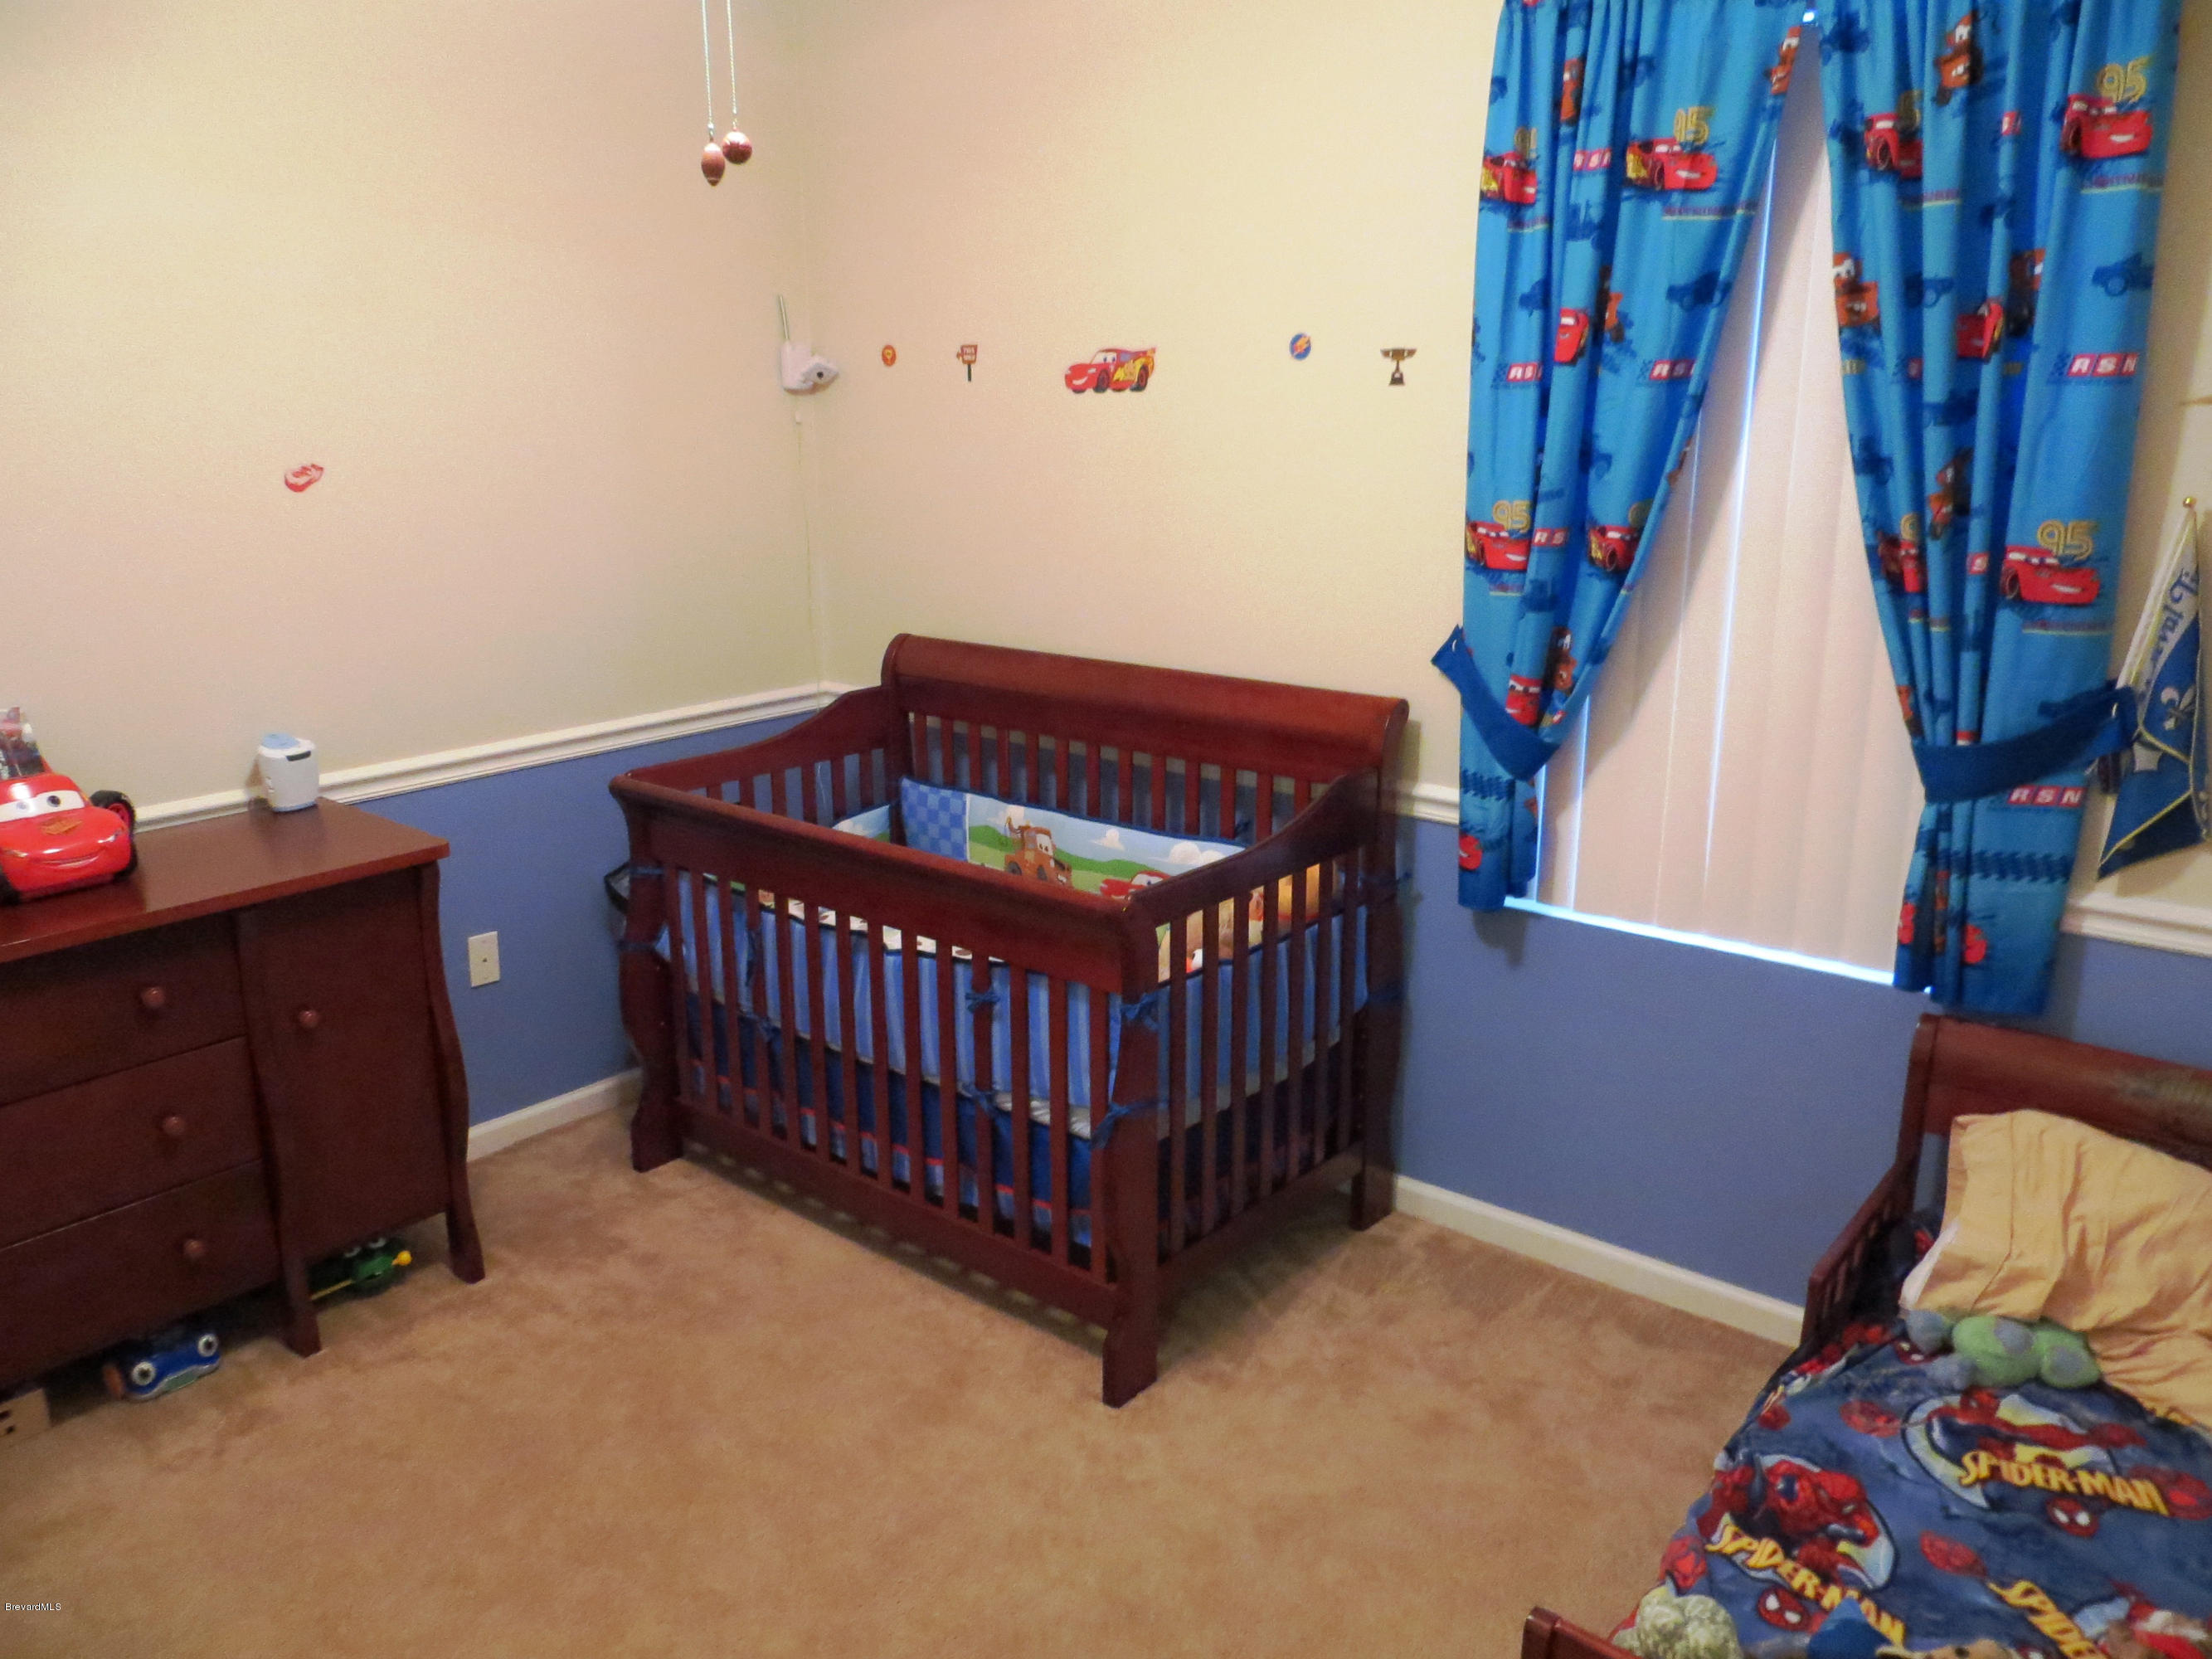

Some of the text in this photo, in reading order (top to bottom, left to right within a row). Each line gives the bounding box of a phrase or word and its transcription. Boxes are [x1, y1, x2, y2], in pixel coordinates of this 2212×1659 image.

[2096, 55, 2158, 103] 95
[1492, 499, 1533, 533] 95
[2037, 519, 2101, 561] 95
[1958, 1449, 2170, 1516] SPIDER-MAN
